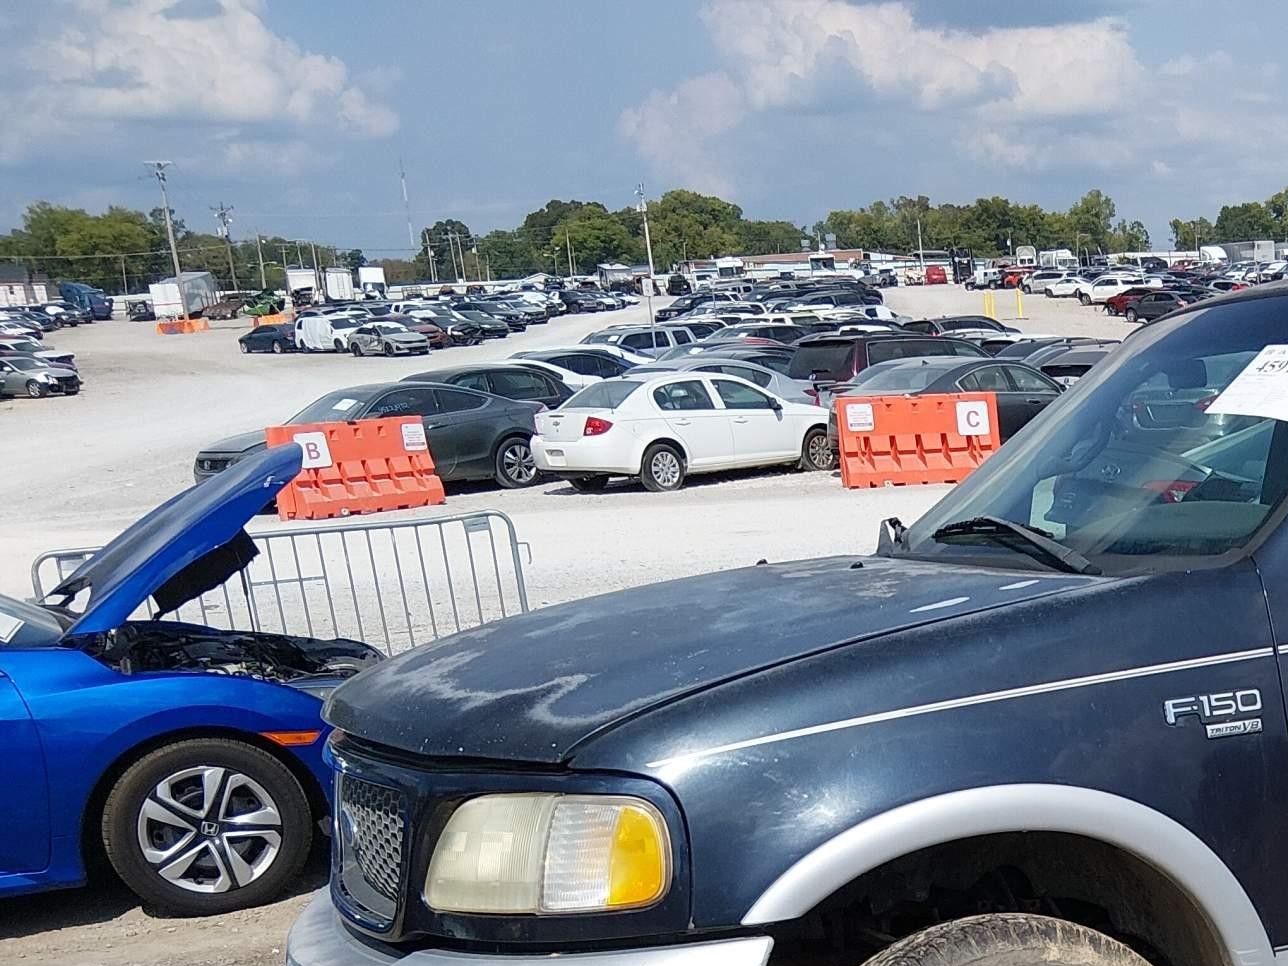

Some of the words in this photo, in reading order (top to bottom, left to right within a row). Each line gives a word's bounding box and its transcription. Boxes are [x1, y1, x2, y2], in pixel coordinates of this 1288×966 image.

[966, 410, 980, 428] C
[305, 442, 321, 460] B
[1209, 725, 1242, 737] TRITON
[1241, 720, 1260, 733] V8
